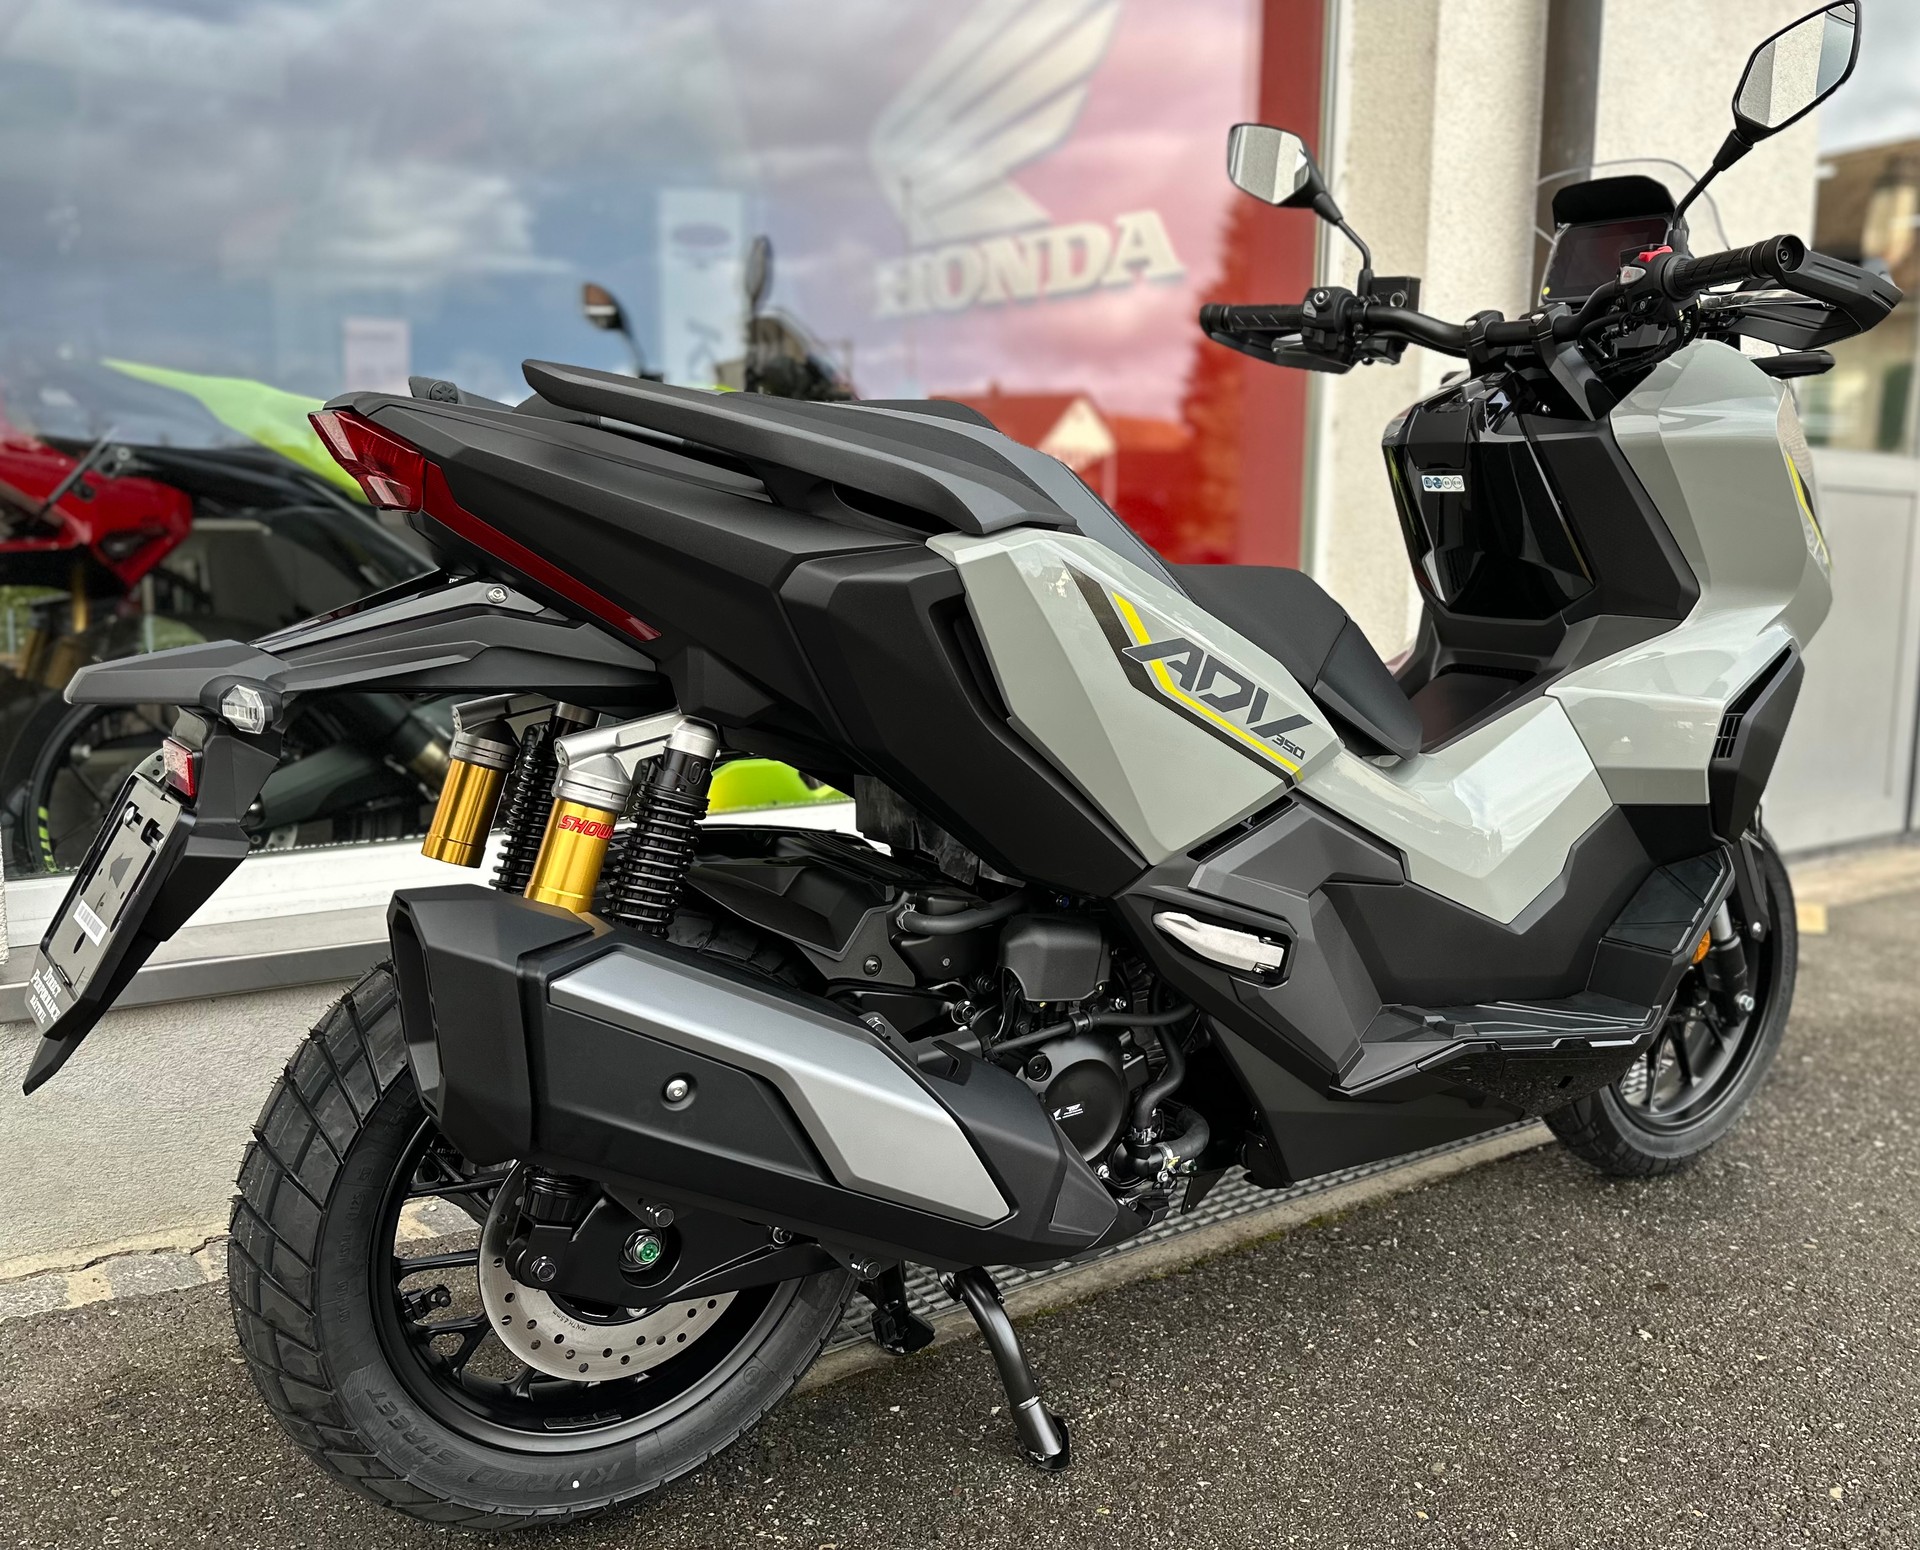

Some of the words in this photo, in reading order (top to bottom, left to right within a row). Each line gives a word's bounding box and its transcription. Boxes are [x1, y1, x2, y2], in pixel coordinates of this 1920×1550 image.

[873, 209, 1186, 318] HONDA
[1121, 637, 1313, 739] ADV
[1271, 734, 1306, 761] 350
[559, 814, 615, 840] SHOW
[366, 1388, 460, 1466] STREET
